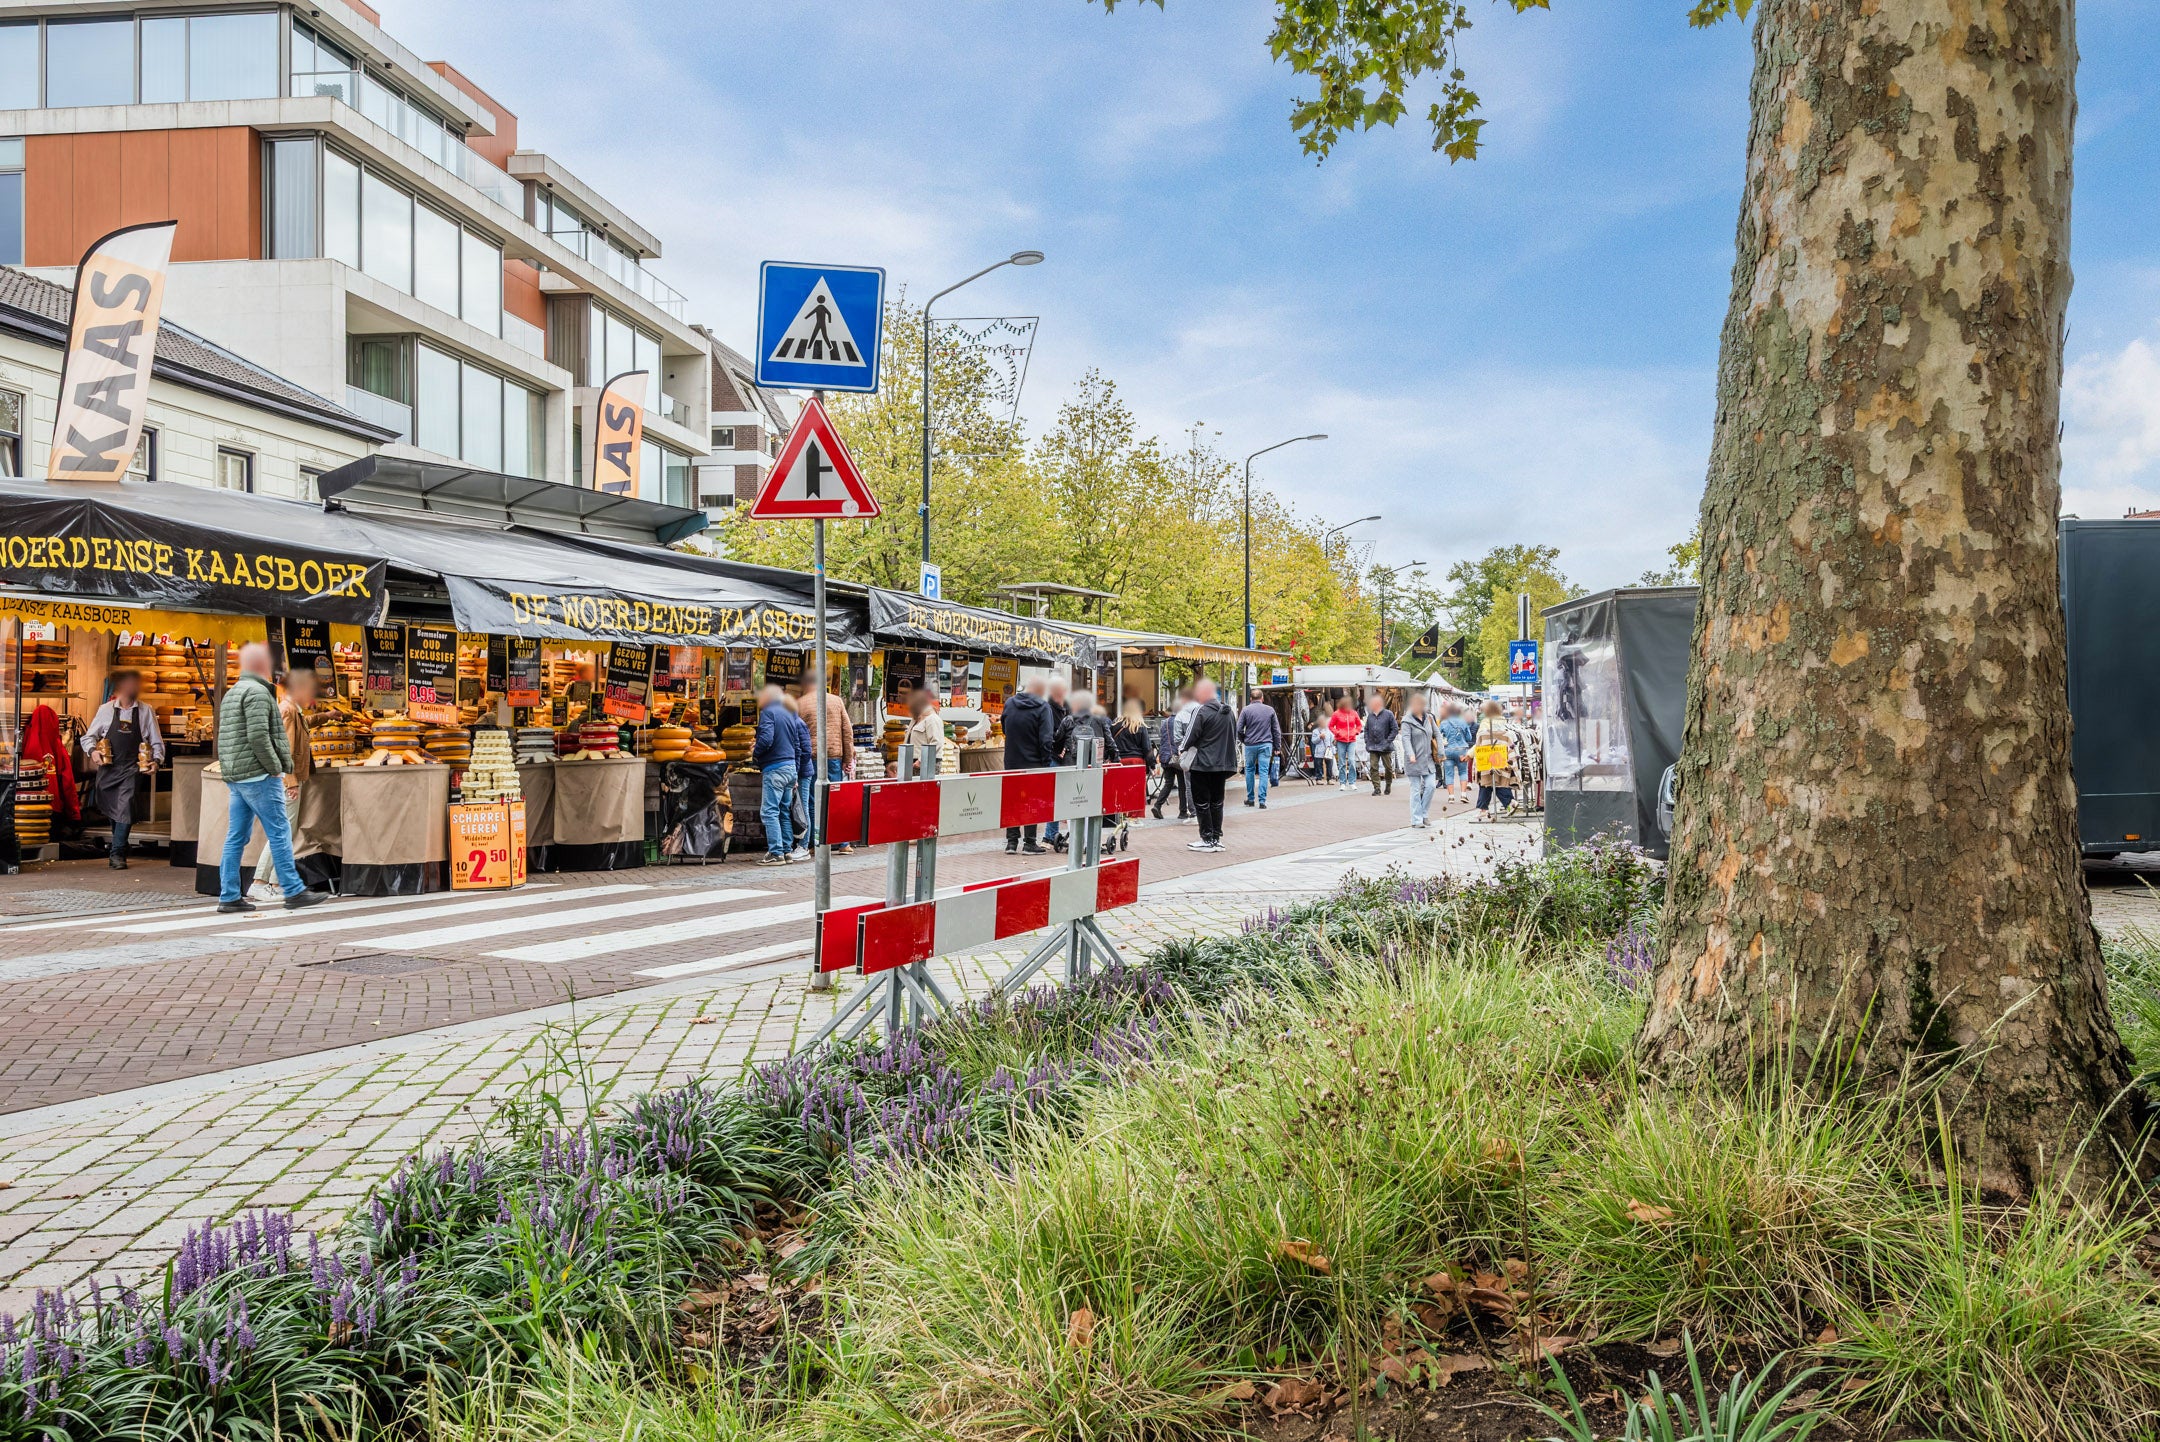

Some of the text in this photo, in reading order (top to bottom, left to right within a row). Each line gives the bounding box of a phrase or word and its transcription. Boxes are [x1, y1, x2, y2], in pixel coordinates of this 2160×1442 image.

[60, 270, 151, 473] KAAS
[185, 548, 371, 598] KAASBOER
[52, 603, 131, 625] KAASBOER
[510, 592, 827, 640] DE WOERDENSE KAASBOE
[373, 629, 399, 640] GRAND
[908, 604, 1075, 656] DE WOERDENSE KAASBOER
[295, 638, 321, 647] BELEGEN
[380, 640, 395, 650] CRU
[422, 639, 441, 650] OUD
[409, 648, 455, 663] EXCLUSIEF
[616, 647, 647, 661] GEZOND
[772, 655, 800, 666] GEZOND
[614, 657, 647, 671] 18% VET
[770, 664, 785, 673] 18%
[367, 675, 392, 691] 8.95
[409, 685, 436, 703] 8.95
[606, 684, 629, 701] 8.95
[416, 711, 450, 722] GARANTIE
[452, 811, 506, 824] SCHARREL
[461, 822, 498, 835] EIEREN
[456, 861, 467, 872] 10
